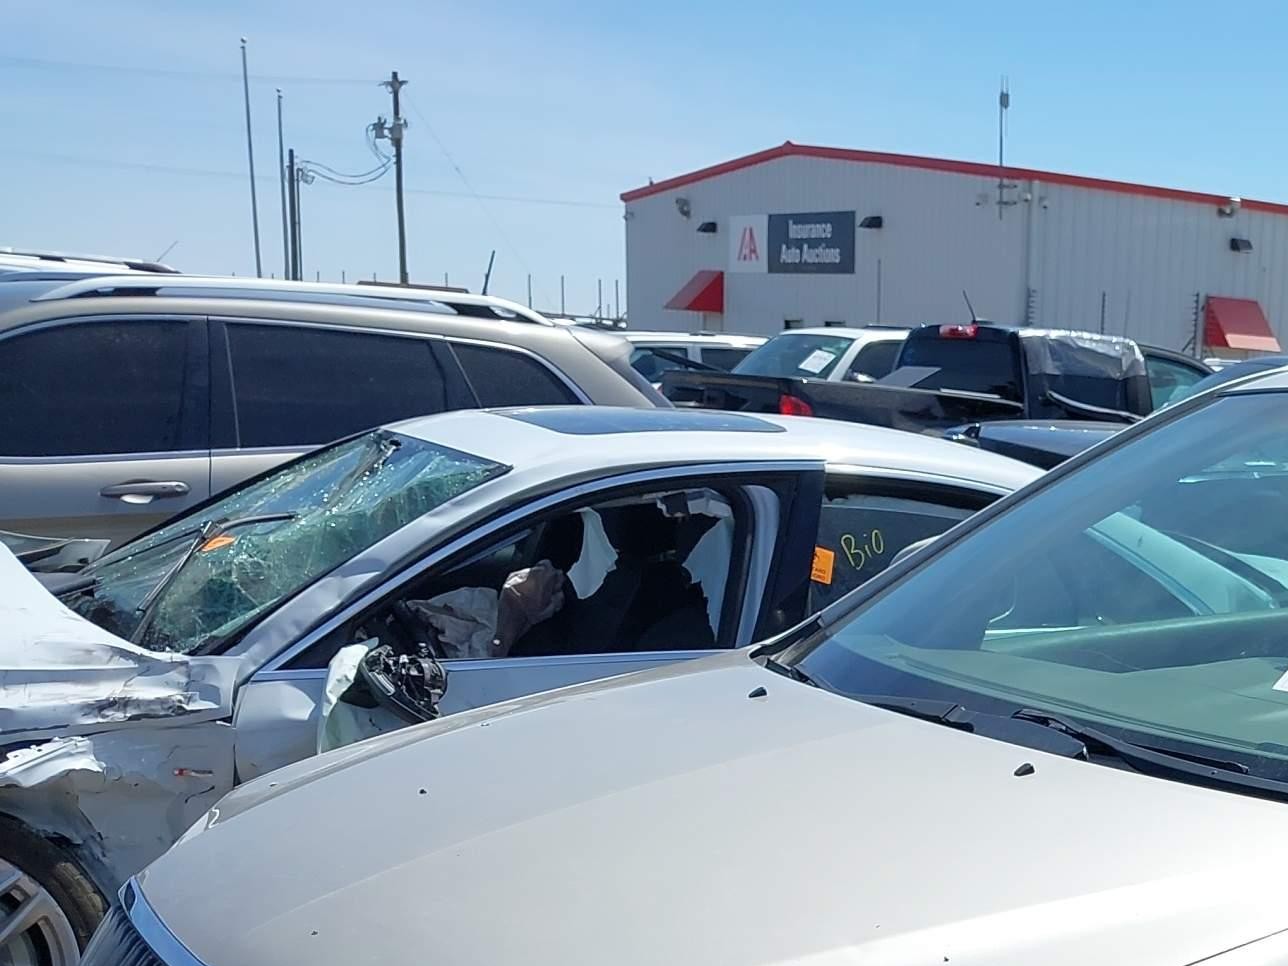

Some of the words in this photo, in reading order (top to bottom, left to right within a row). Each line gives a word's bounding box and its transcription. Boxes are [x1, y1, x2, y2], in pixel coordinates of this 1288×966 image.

[788, 219, 833, 240] Insurance
[779, 243, 801, 264] Auto
[801, 243, 841, 264] Auctions
